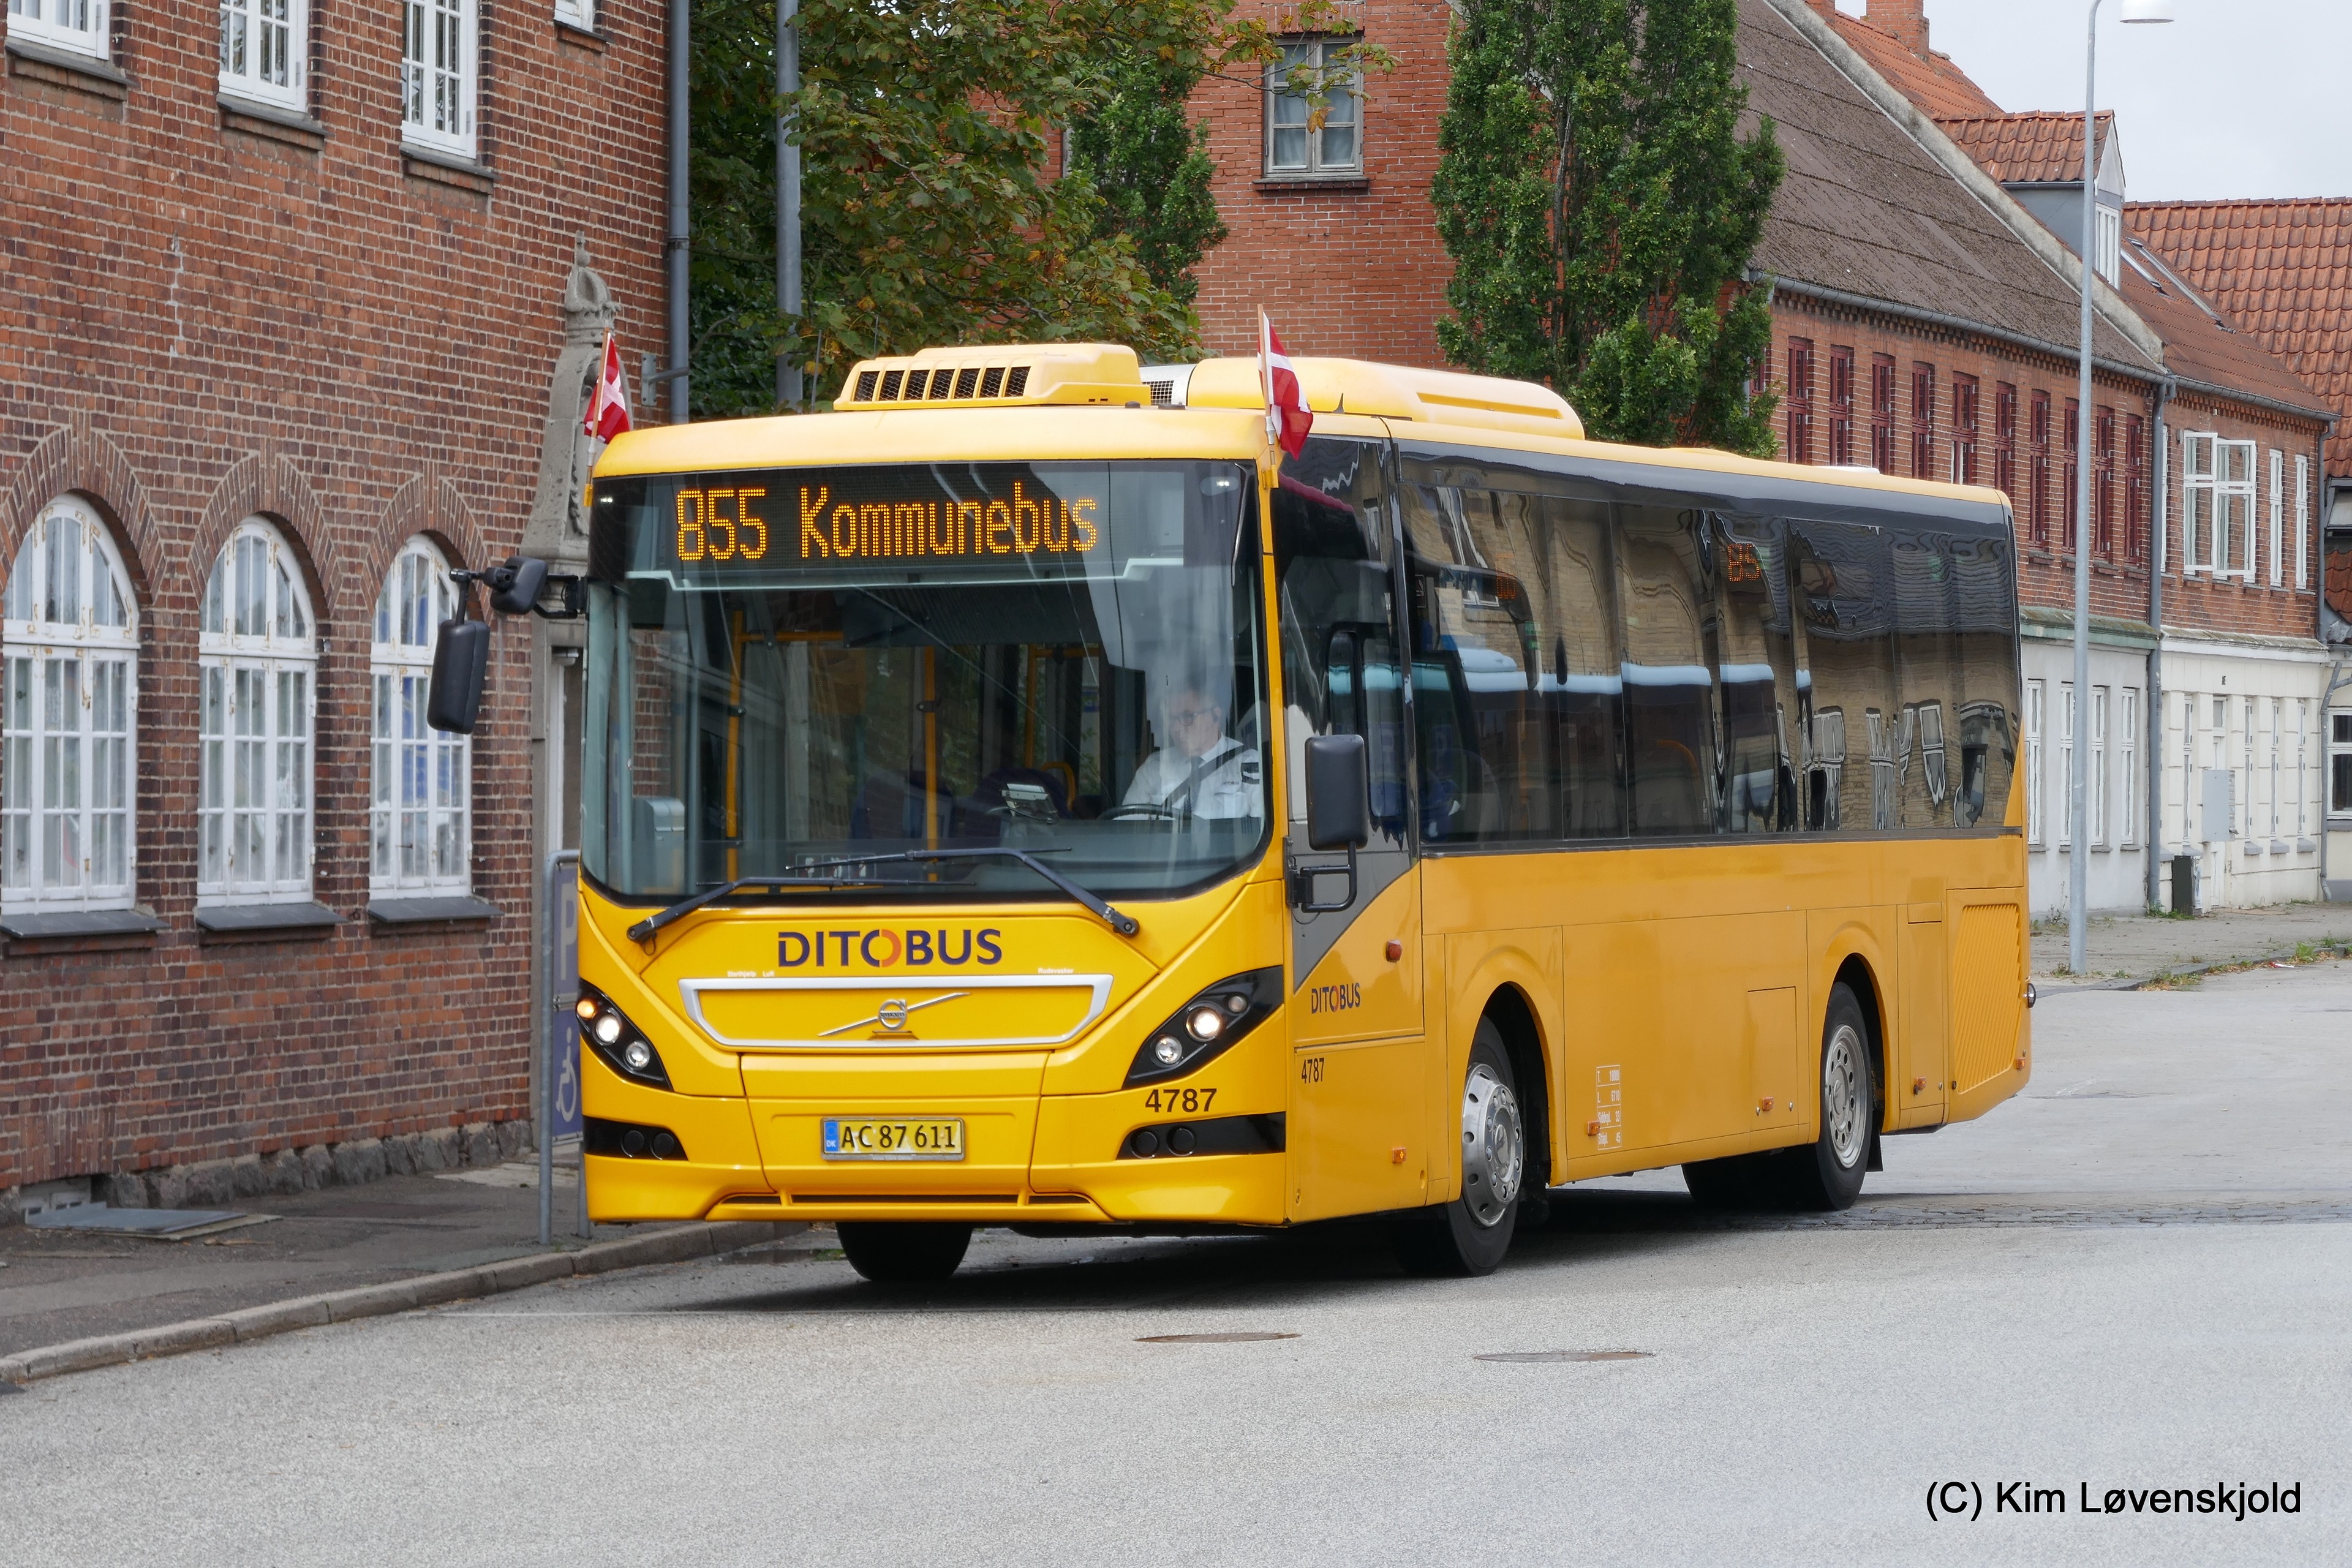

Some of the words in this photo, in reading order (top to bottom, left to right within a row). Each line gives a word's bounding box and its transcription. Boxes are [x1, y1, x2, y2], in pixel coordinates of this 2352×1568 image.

[677, 489, 768, 560] 855
[801, 481, 1097, 558] Kommunebus
[560, 882, 577, 980] P
[778, 929, 1002, 967] DITOBUS
[1311, 982, 1360, 1014] DITOBUS
[1302, 1057, 1325, 1084] 4787
[1145, 1088, 1217, 1112] 4787
[842, 1126, 872, 1148] AC
[880, 1125, 907, 1148] 87
[915, 1125, 955, 1148] 611
